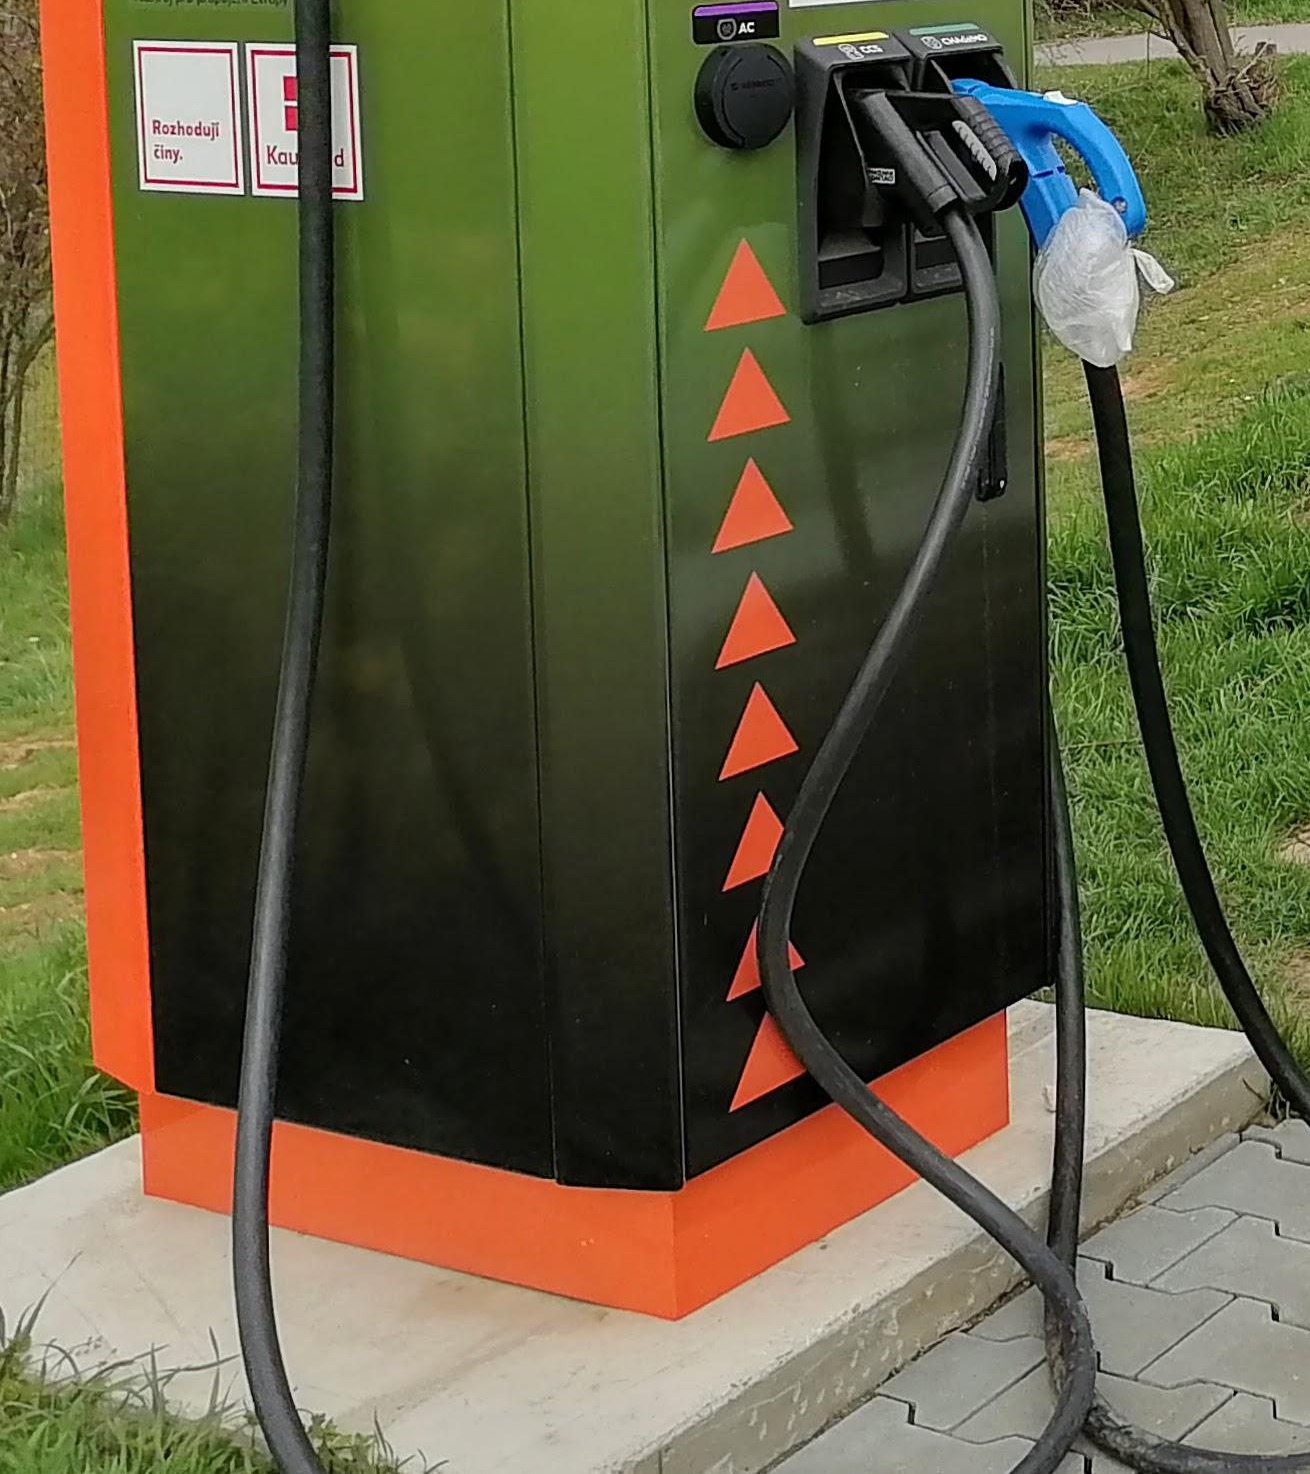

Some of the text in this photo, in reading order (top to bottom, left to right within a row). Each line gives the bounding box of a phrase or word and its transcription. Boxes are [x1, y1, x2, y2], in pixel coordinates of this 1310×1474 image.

[738, 22, 755, 34] AC
[152, 120, 220, 141] Rozhodují
[154, 144, 183, 163] činy.
